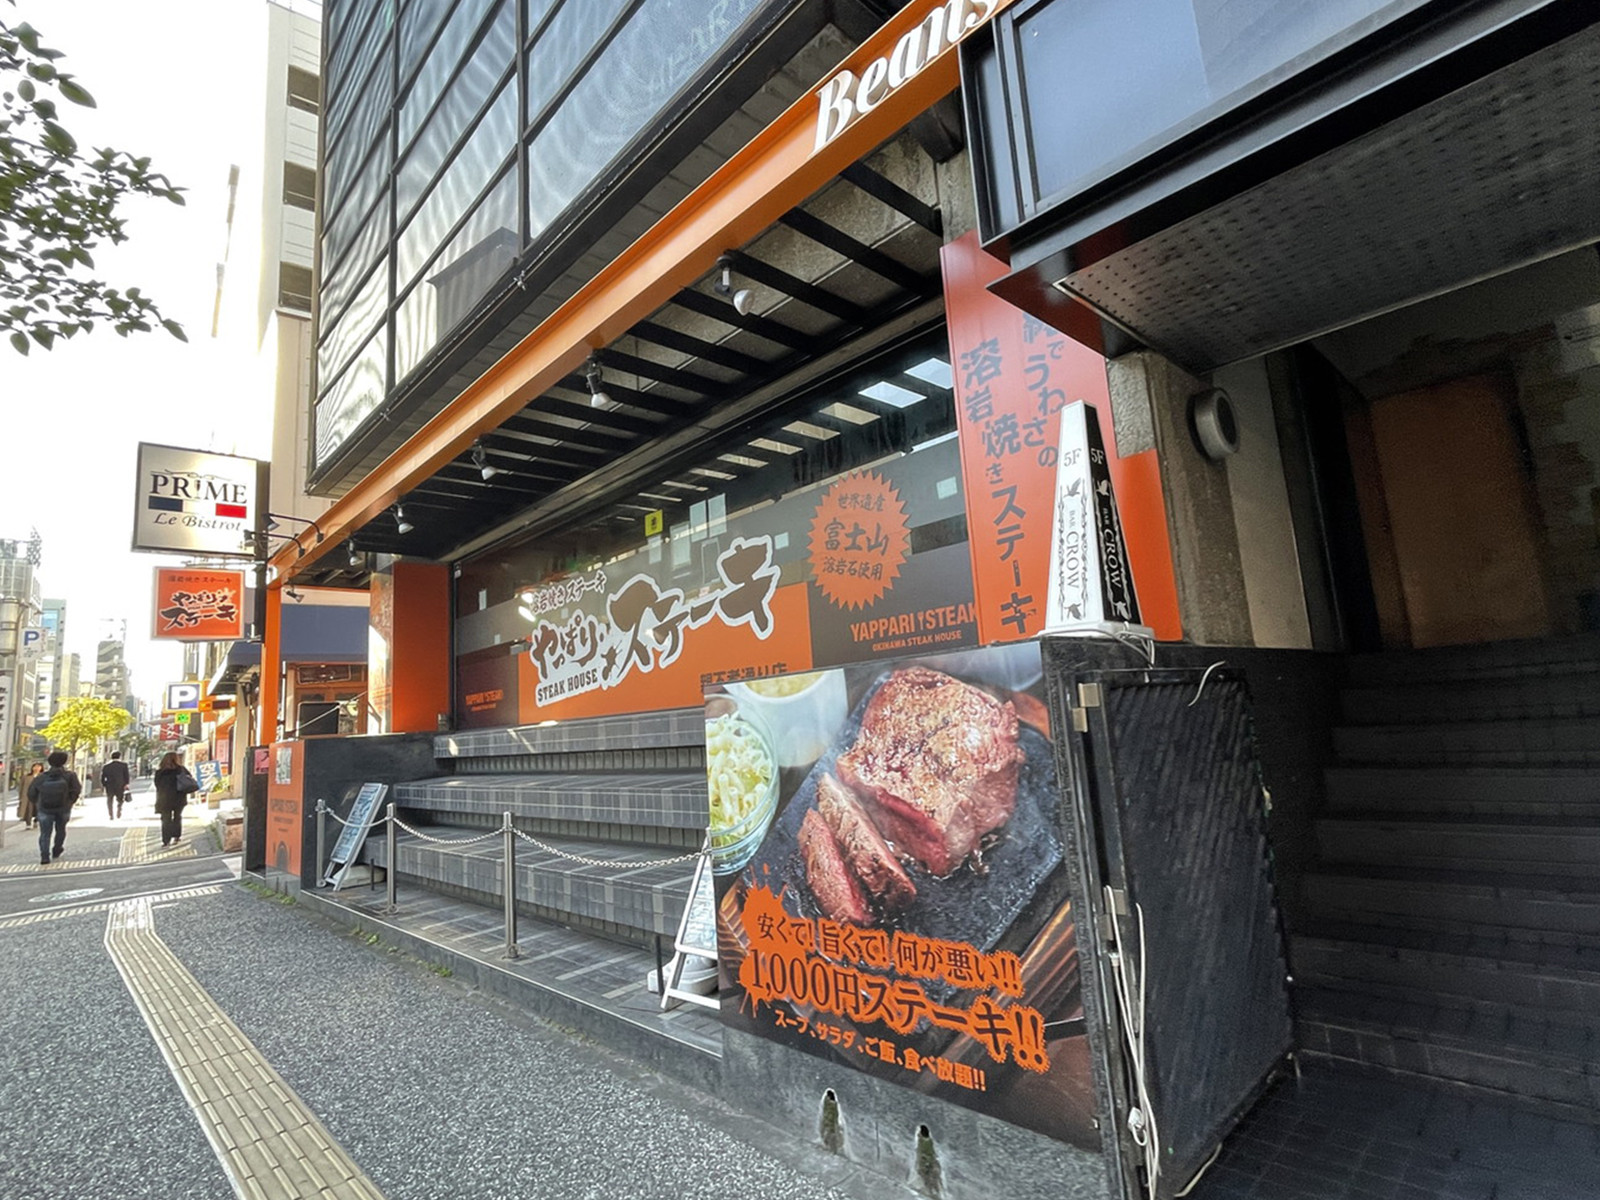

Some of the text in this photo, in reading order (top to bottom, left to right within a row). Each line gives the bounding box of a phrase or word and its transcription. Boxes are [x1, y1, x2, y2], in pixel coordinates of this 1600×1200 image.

[813, 0, 998, 154] Beans
[1063, 448, 1082, 467] 5F
[1090, 447, 1105, 466] 5F
[837, 491, 886, 512] 世界遺産
[961, 338, 1036, 634] 溶岩焼きステーキ
[154, 511, 241, 532] Le Bistrot
[823, 517, 890, 557] 富士山
[822, 555, 884, 581] 溶岩石使用
[1065, 531, 1081, 589] CROW
[1104, 528, 1122, 588] CROW
[609, 542, 777, 680] ステーキ
[850, 612, 916, 643] YAPPARI
[906, 635, 933, 648] STEAK
[934, 629, 962, 642] HOUSE
[170, 684, 198, 708] P
[536, 668, 599, 703] STEAK HOUSE
